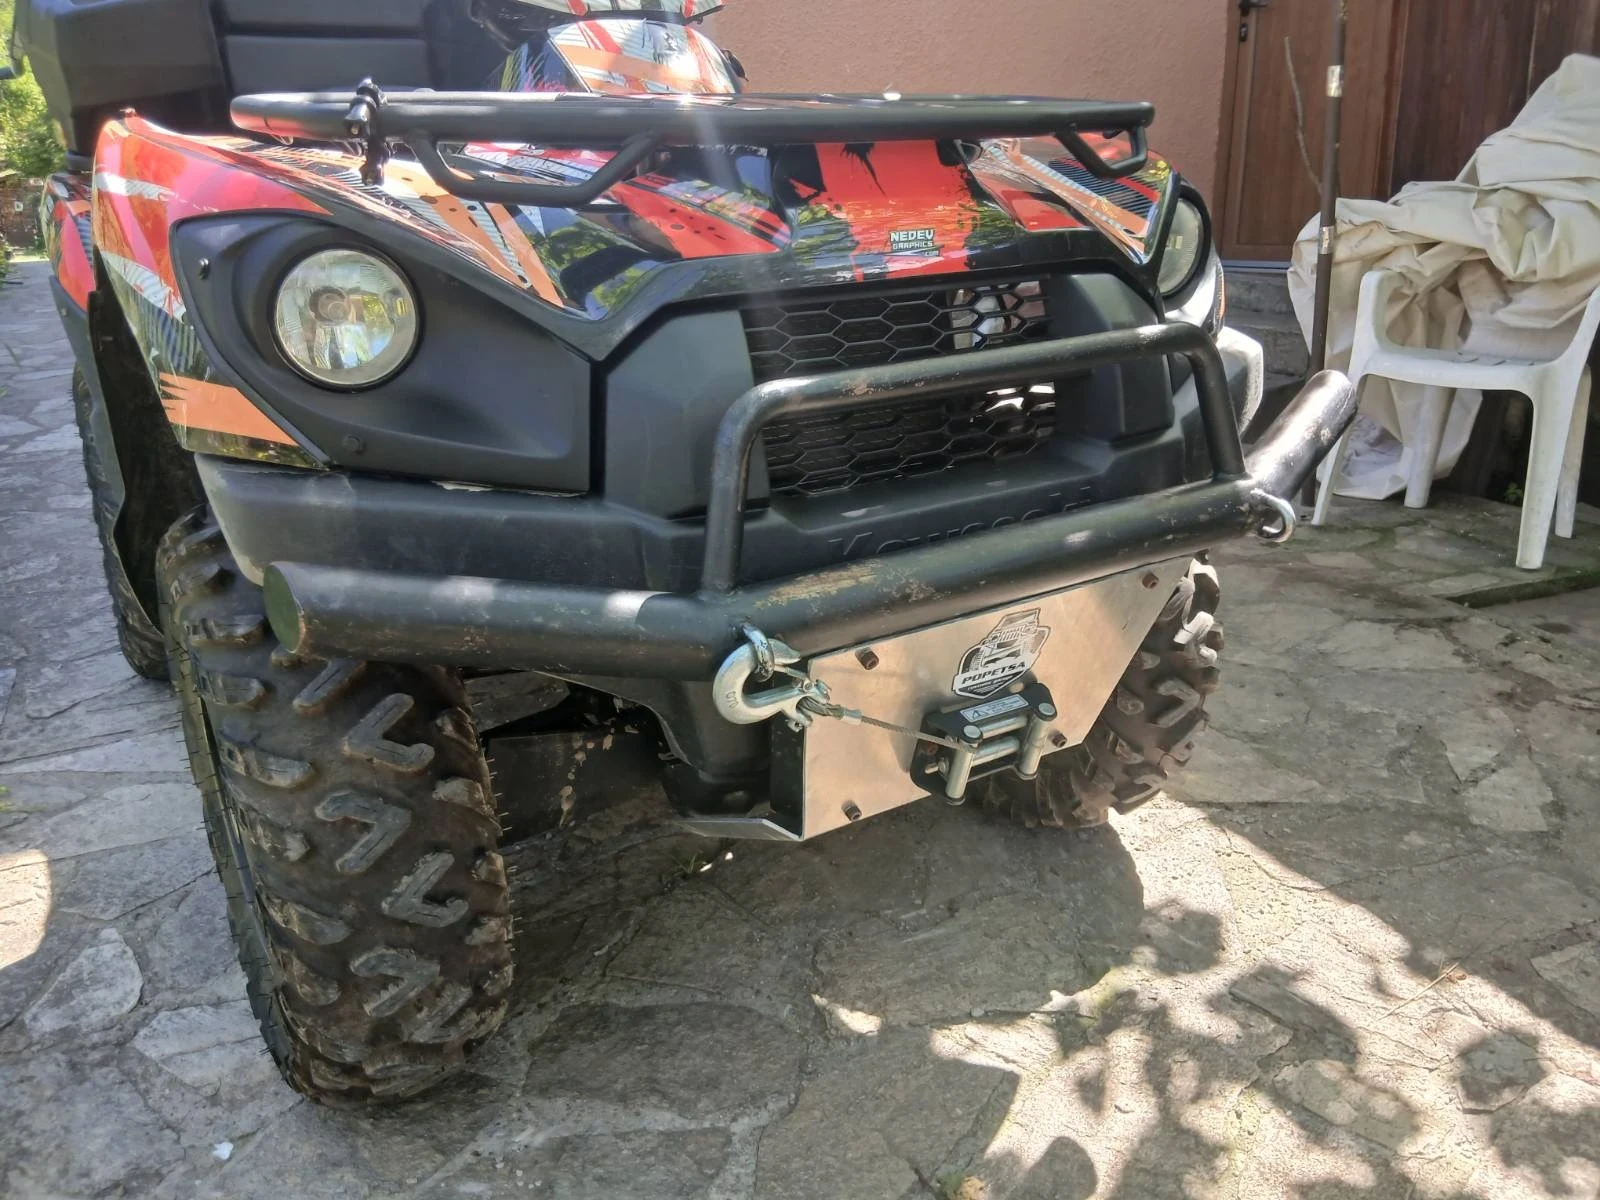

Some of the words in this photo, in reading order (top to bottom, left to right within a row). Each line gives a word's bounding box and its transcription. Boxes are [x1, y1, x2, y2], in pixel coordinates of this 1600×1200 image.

[890, 229, 934, 242] NEDEV
[892, 241, 933, 250] GRAPHICS
[961, 661, 1026, 684] POPETSA
